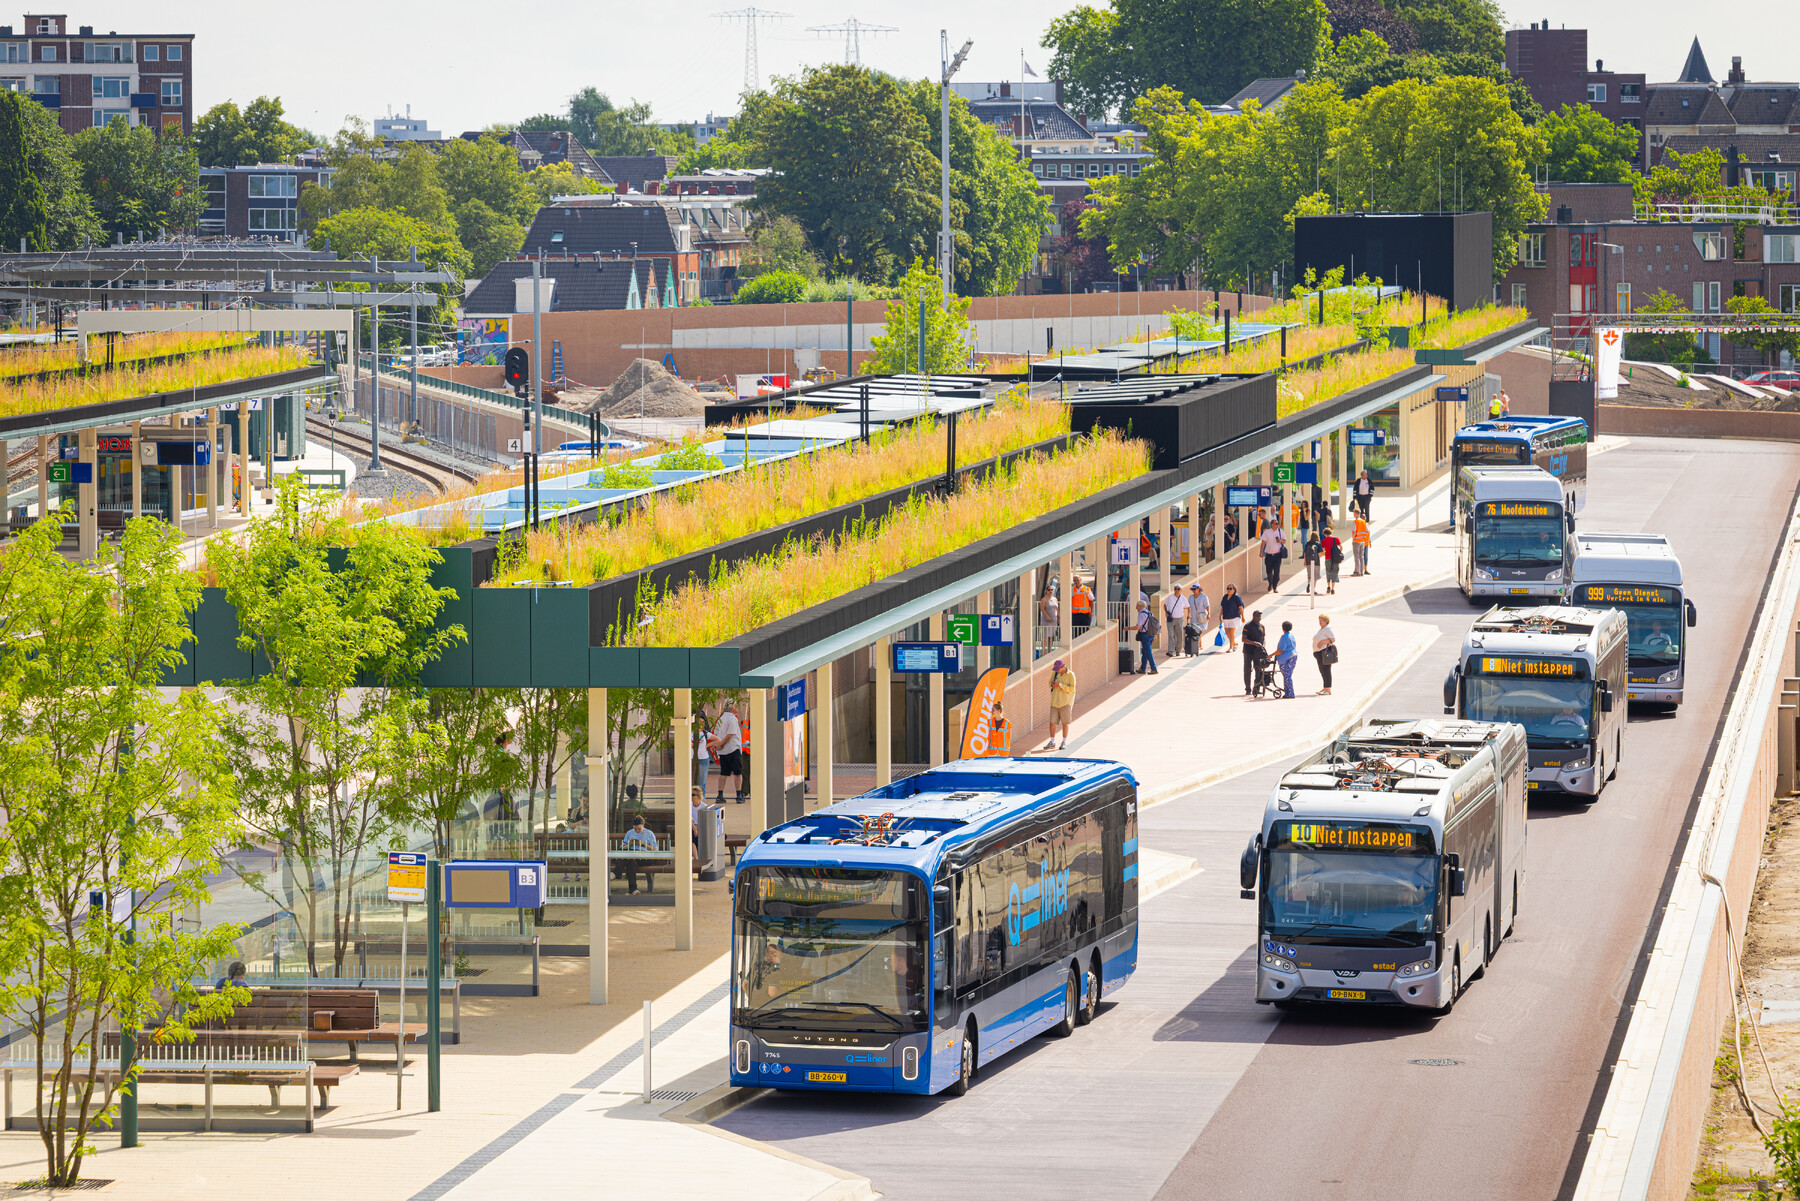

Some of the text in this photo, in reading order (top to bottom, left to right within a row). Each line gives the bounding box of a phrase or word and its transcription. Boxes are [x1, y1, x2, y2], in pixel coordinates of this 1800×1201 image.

[252, 400, 258, 409] 7
[98, 438, 132, 451] KIOSK
[510, 440, 518, 450] 4
[1487, 504, 1548, 516] 76 Hoofdstation
[1588, 587, 1604, 601] 999
[1489, 658, 1573, 675] 8 Niet instappen
[970, 686, 996, 755] Qbuzz
[1295, 825, 1412, 847] 10 Niet instappen
[521, 874, 535, 884] B3
[759, 878, 775, 897] 50
[1379, 962, 1396, 970] stad
[1331, 990, 1364, 999] 09-BNX-S
[810, 1072, 844, 1081] BB-260-V
